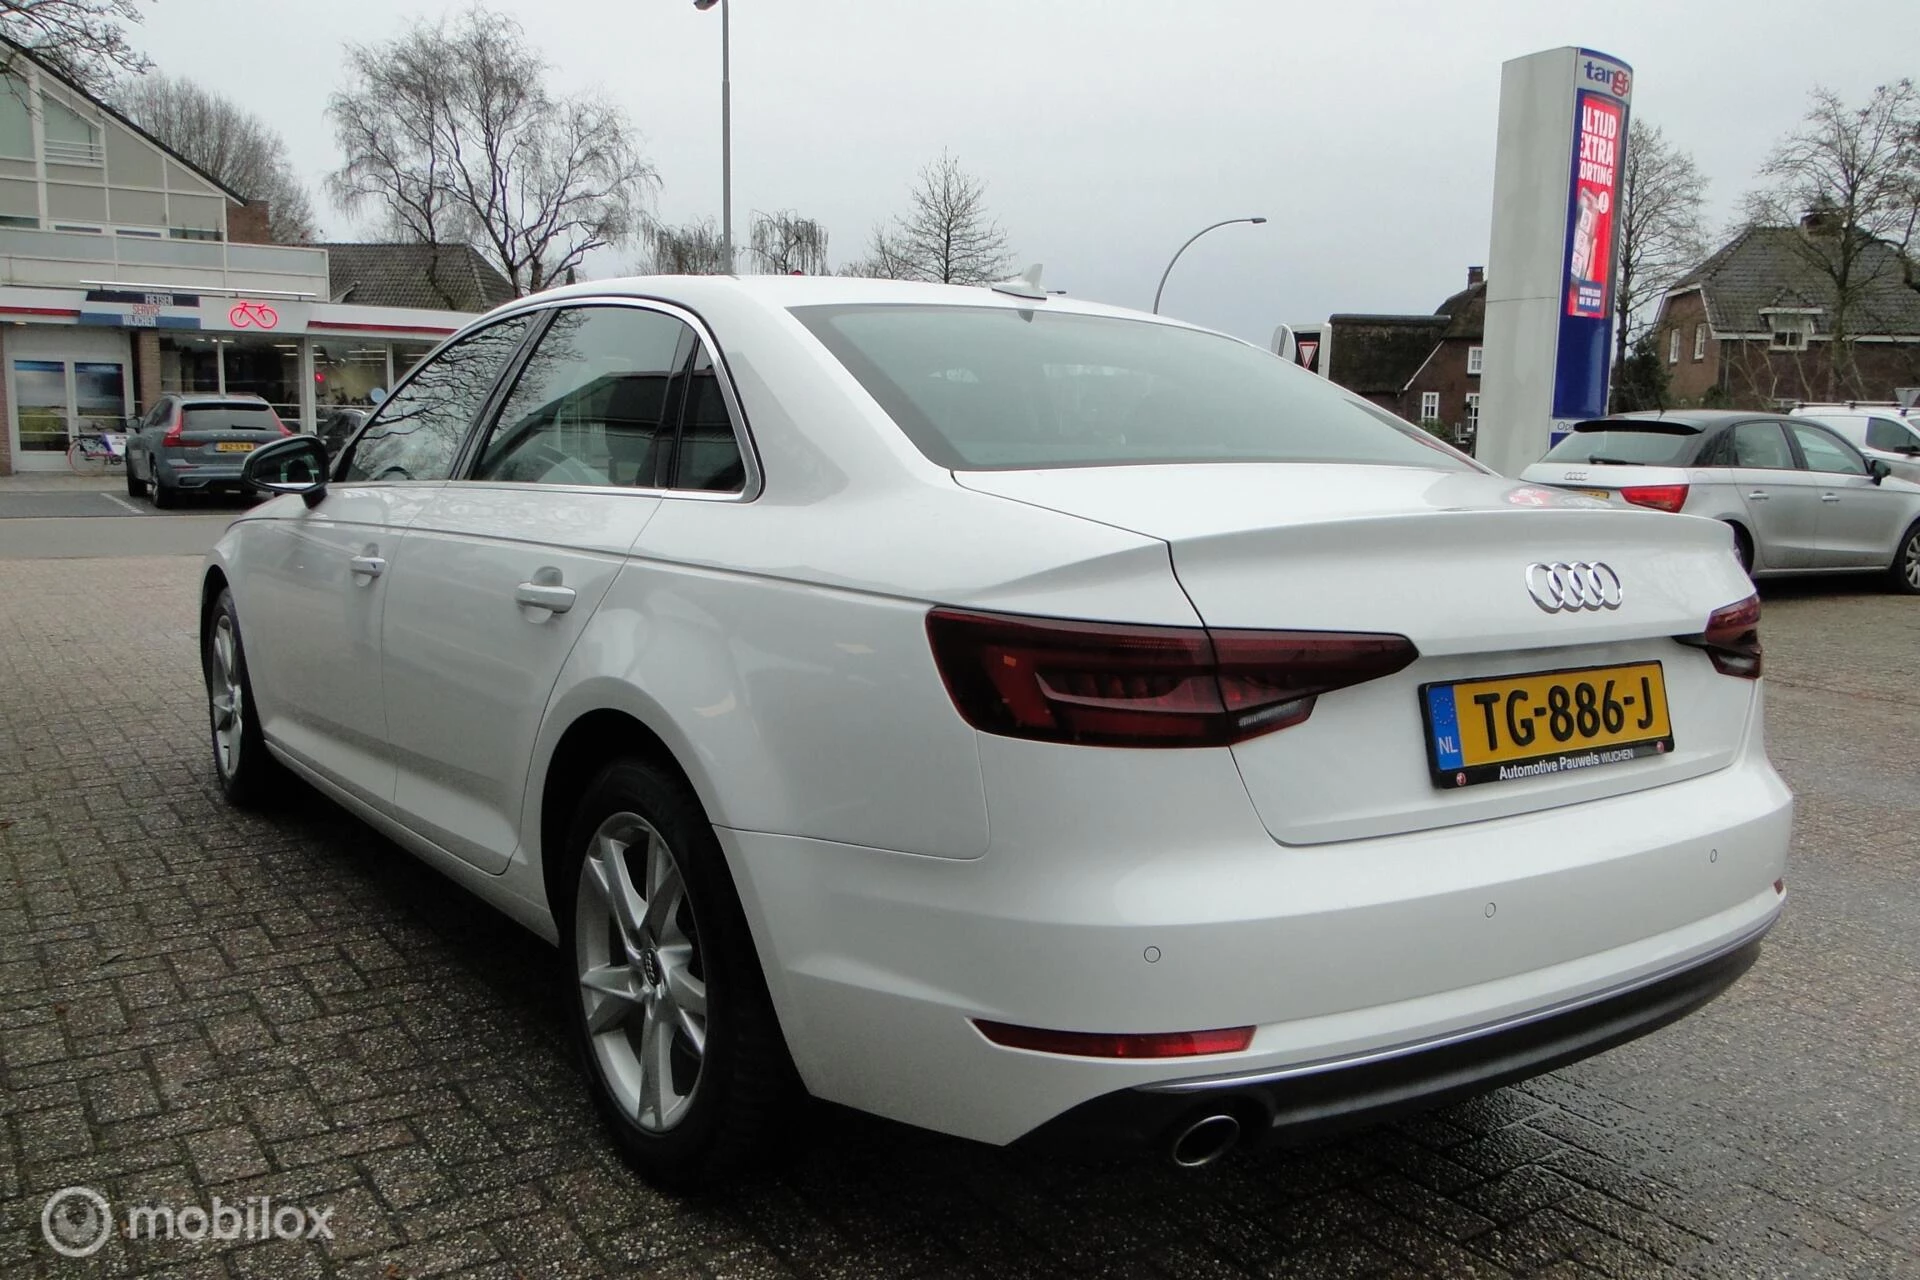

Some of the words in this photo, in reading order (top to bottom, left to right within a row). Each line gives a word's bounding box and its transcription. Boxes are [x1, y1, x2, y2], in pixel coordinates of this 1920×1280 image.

[1578, 161, 1613, 186] ORTING
[1474, 677, 1654, 751] TG-886-J
[1438, 736, 1458, 754] NL
[1500, 759, 1557, 780] Automotive
[1560, 752, 1600, 770] Pauwels
